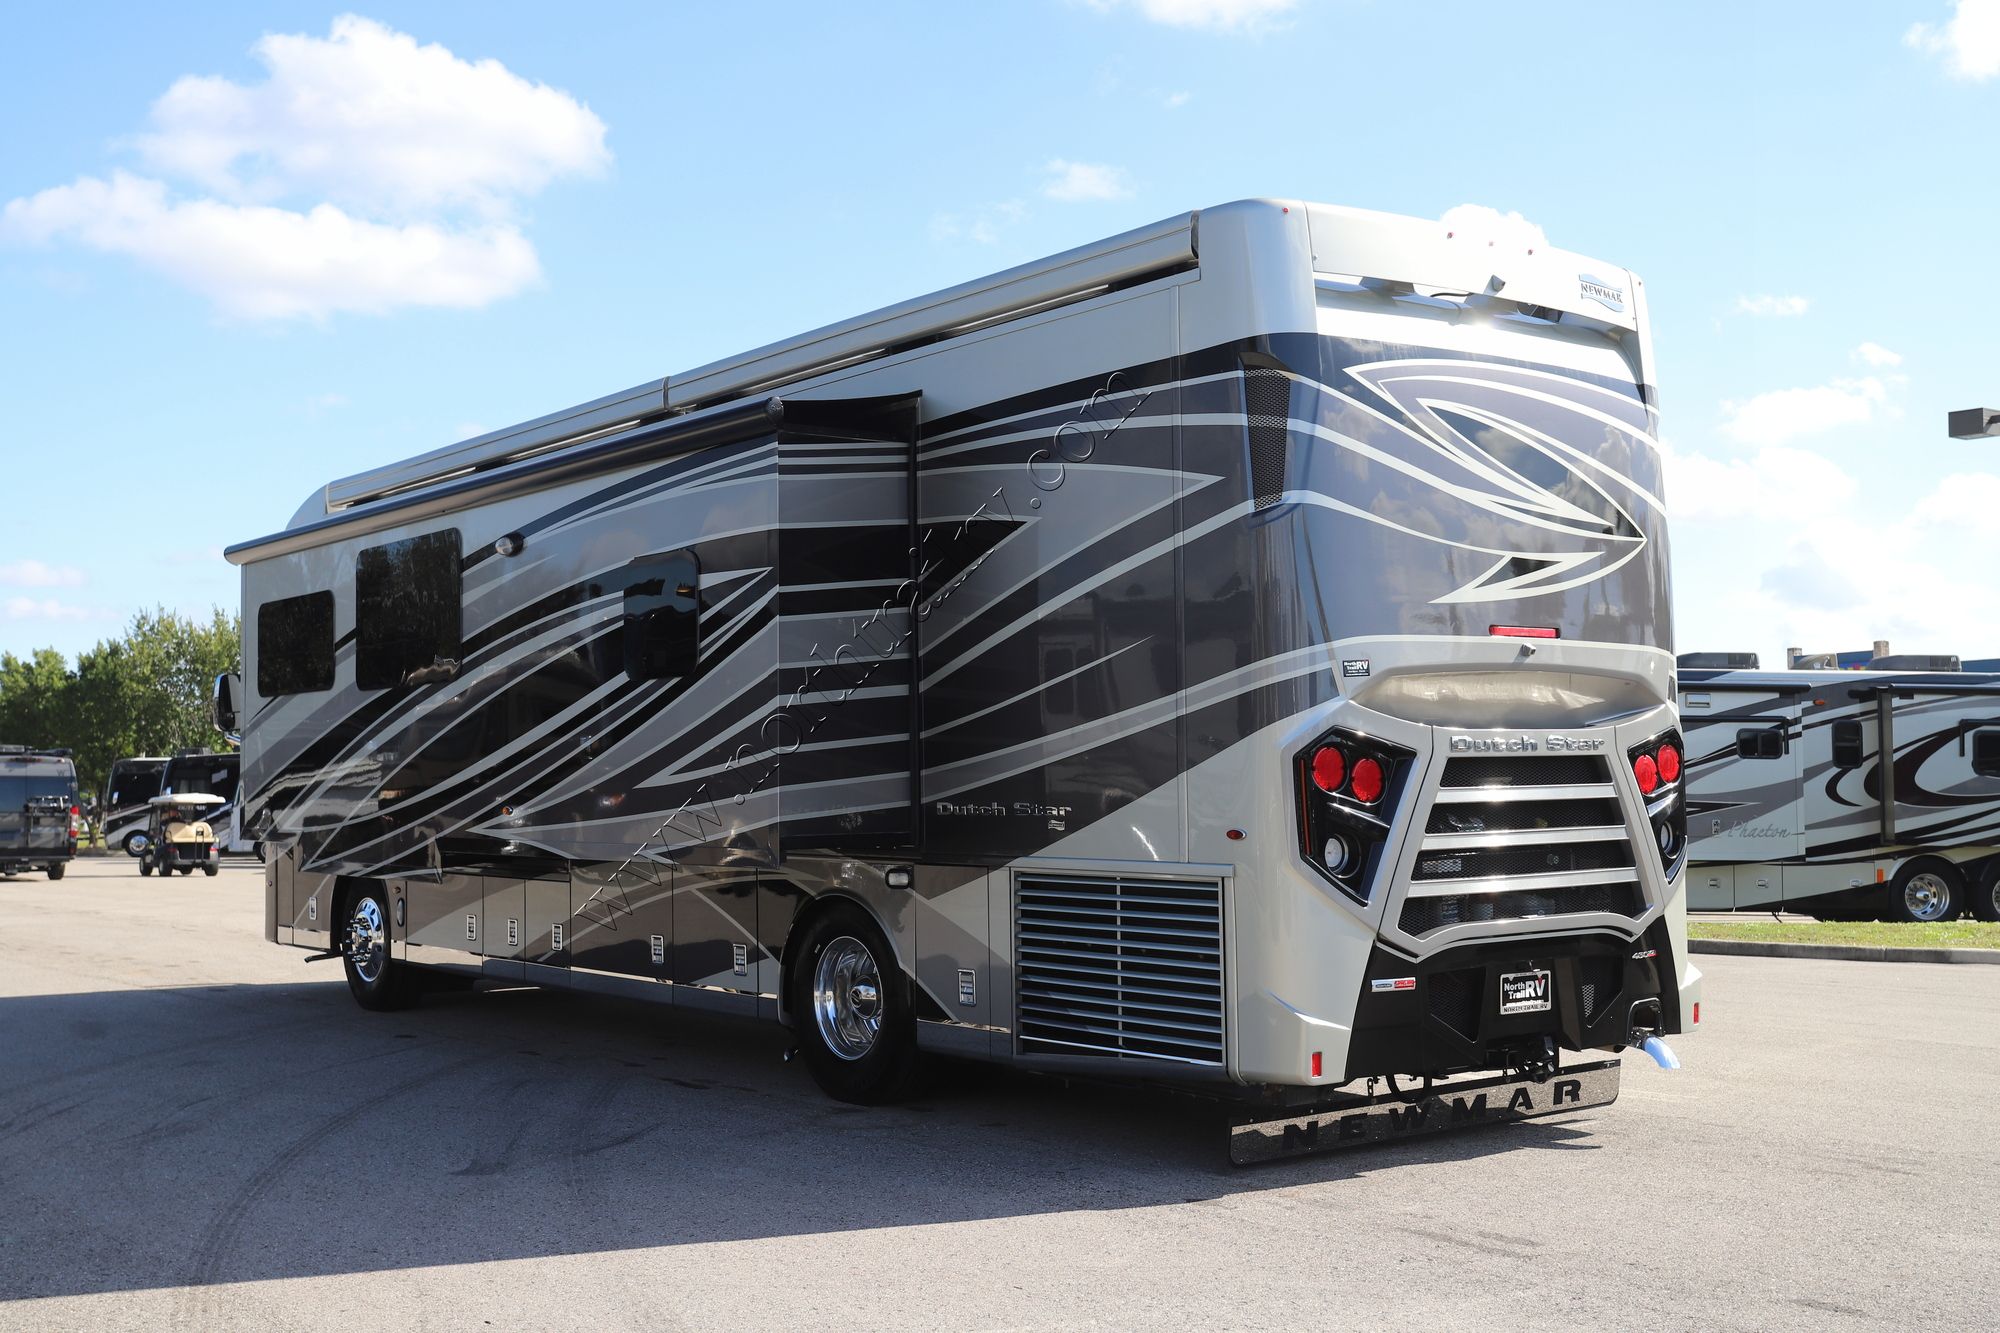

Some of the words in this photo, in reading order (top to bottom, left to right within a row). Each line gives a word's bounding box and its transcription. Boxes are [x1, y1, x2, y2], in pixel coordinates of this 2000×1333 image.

[1580, 283, 1623, 303] NEWMAR
[1450, 735, 1538, 752] Dutch
[1546, 734, 1605, 751] Star
[937, 802, 1006, 816] Dutch
[1013, 802, 1072, 816] Star
[1504, 982, 1525, 991] North
[1508, 991, 1525, 999] Trail
[1526, 980, 1545, 998] RV
[1282, 1079, 1582, 1150] NEWMAR
